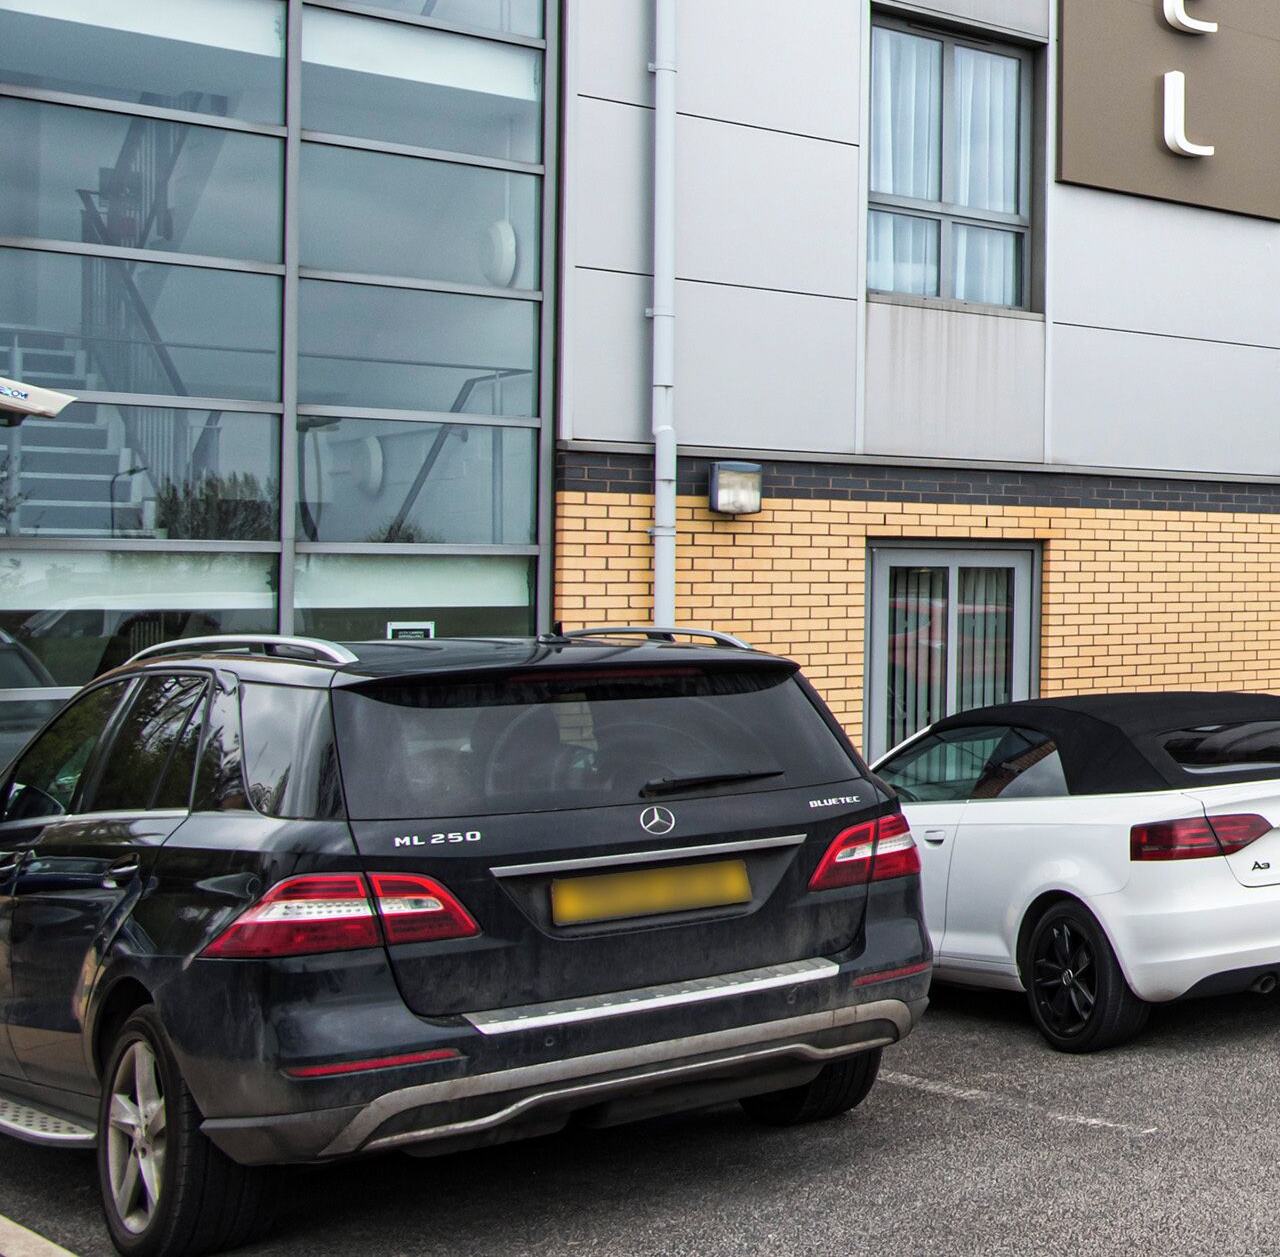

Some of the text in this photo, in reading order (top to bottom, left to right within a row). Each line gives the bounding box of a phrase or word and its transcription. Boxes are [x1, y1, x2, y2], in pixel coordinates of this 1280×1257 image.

[808, 796, 860, 807] BLUETEC
[394, 830, 481, 847] ML 250
[1252, 861, 1270, 871] A3
